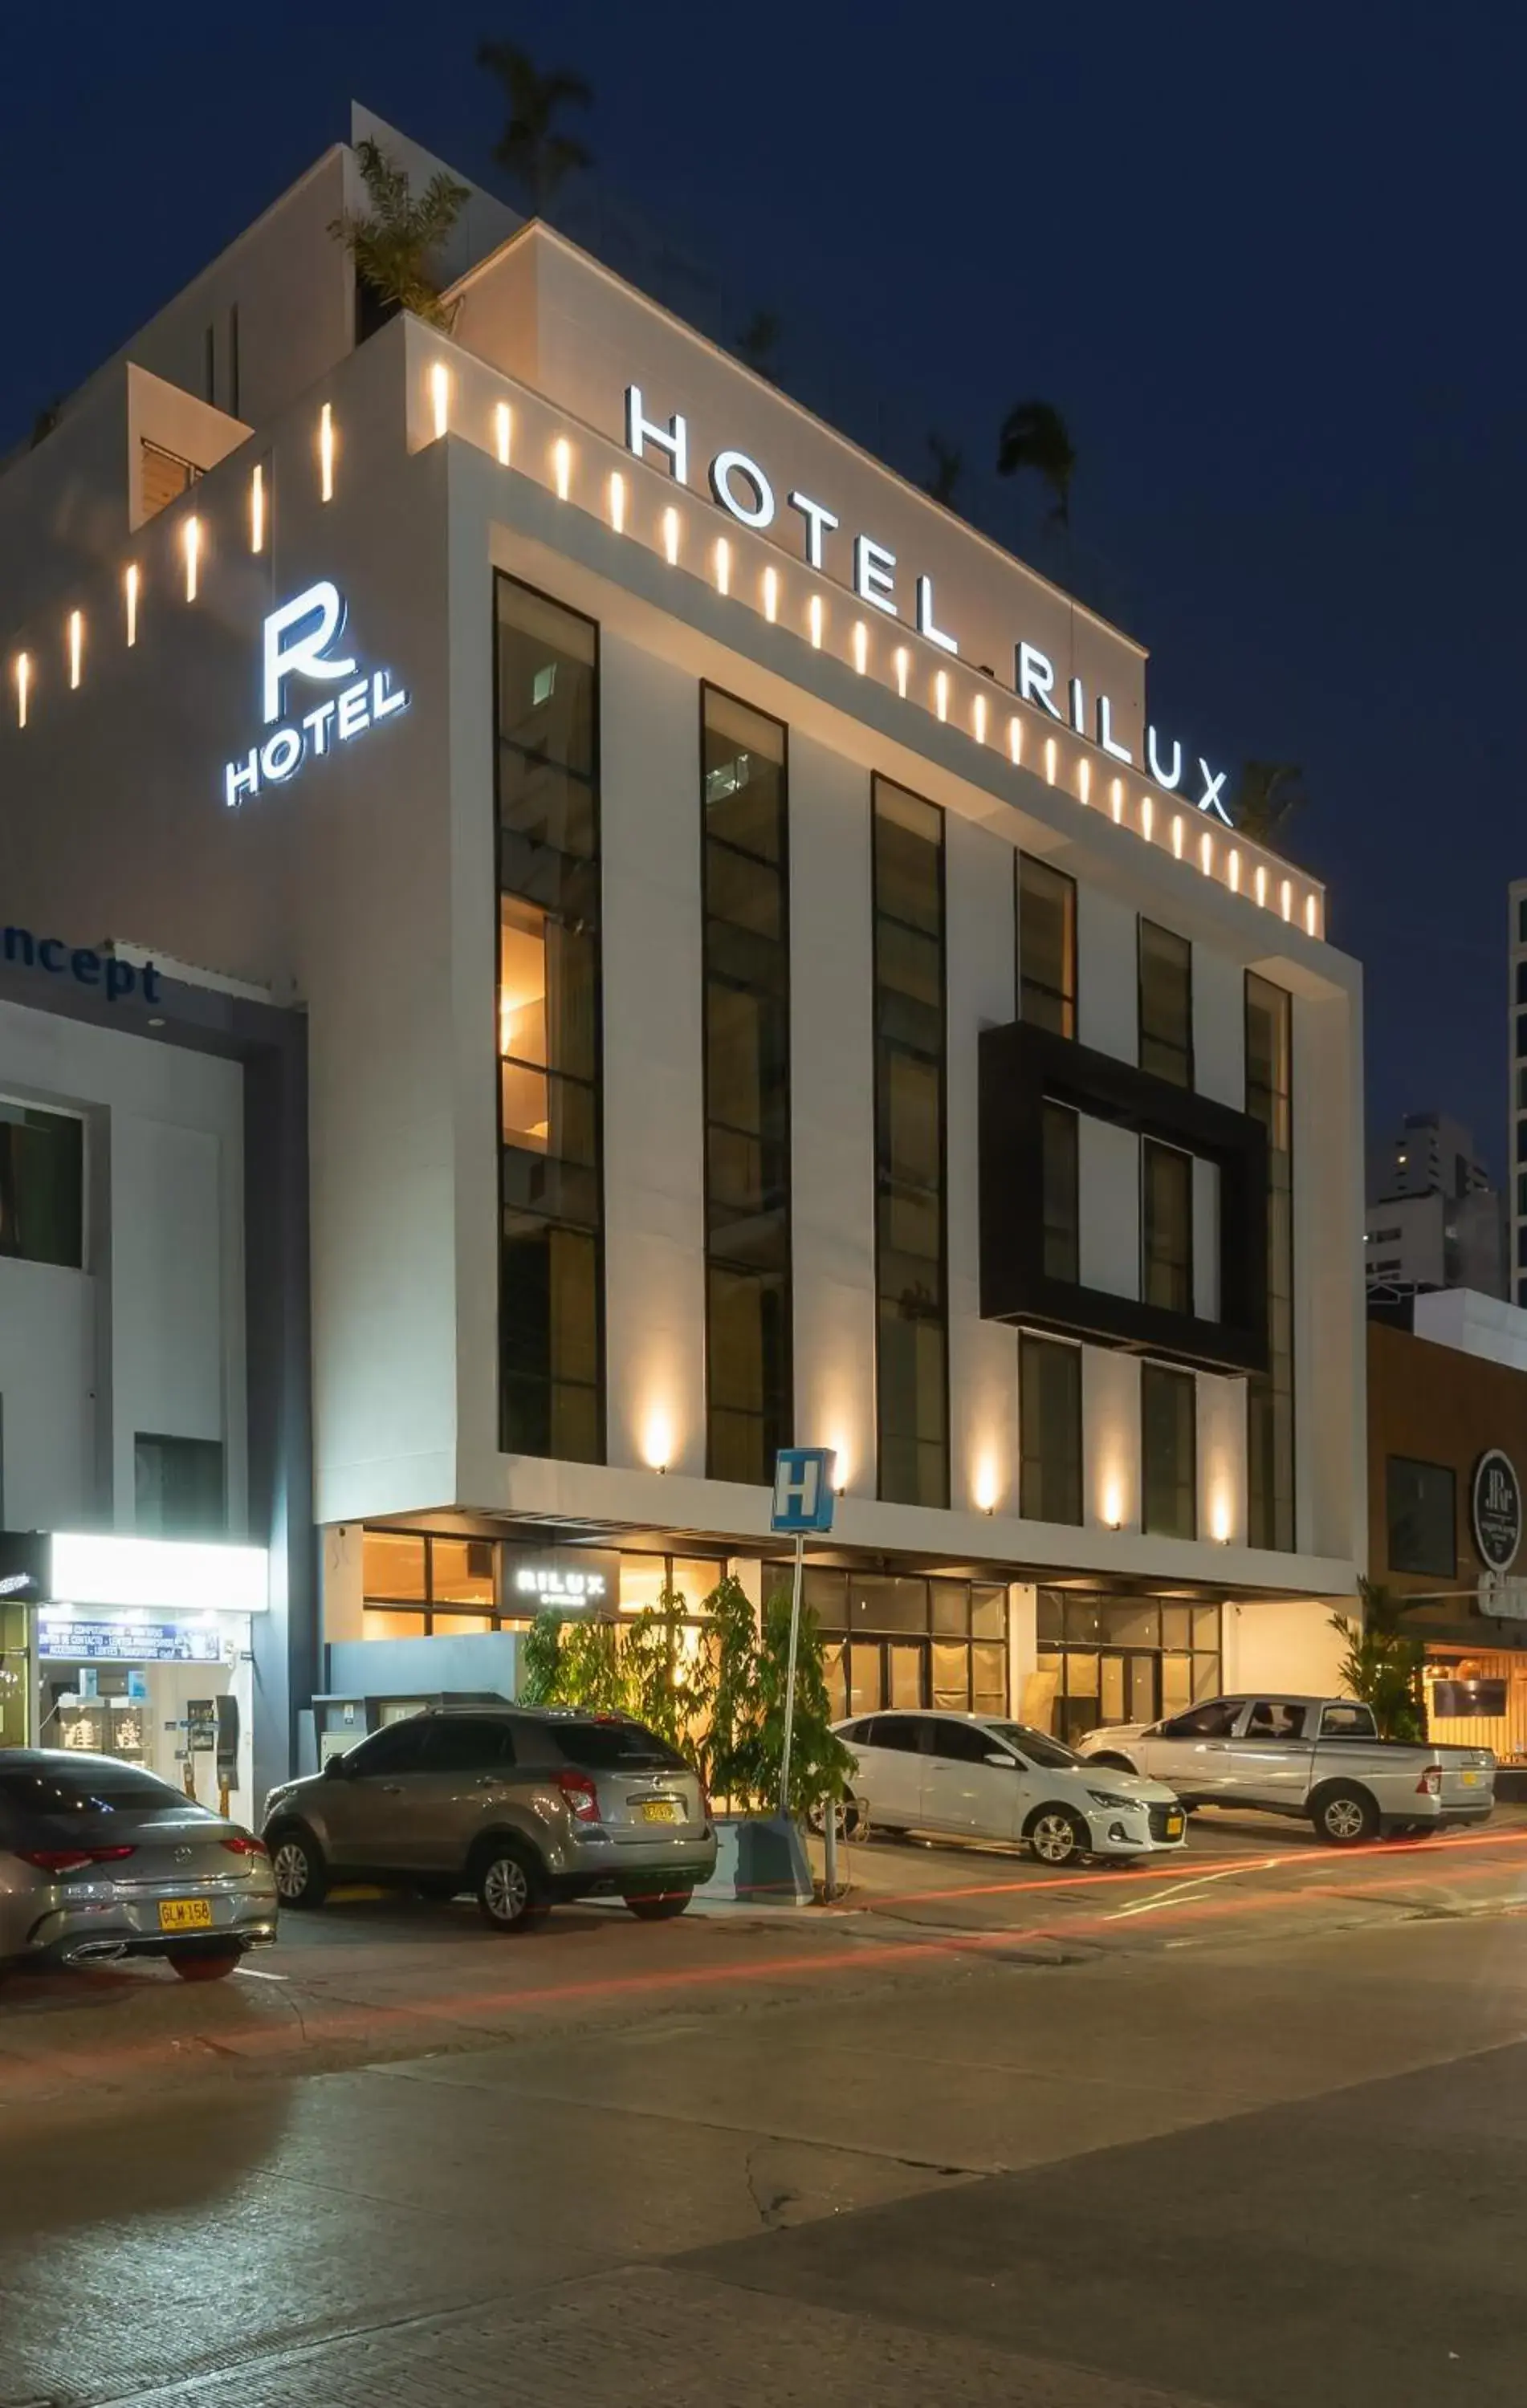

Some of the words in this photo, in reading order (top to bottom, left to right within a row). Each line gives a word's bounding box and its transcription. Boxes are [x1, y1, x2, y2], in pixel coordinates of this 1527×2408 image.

[264, 581, 356, 723] R
[625, 384, 957, 653] HOTEL
[1015, 641, 1233, 828] RILUX
[226, 670, 407, 807] HOTEL
[4, 926, 161, 1003] ncept
[775, 1461, 819, 1516] H
[517, 1571, 605, 1595] RILUX
